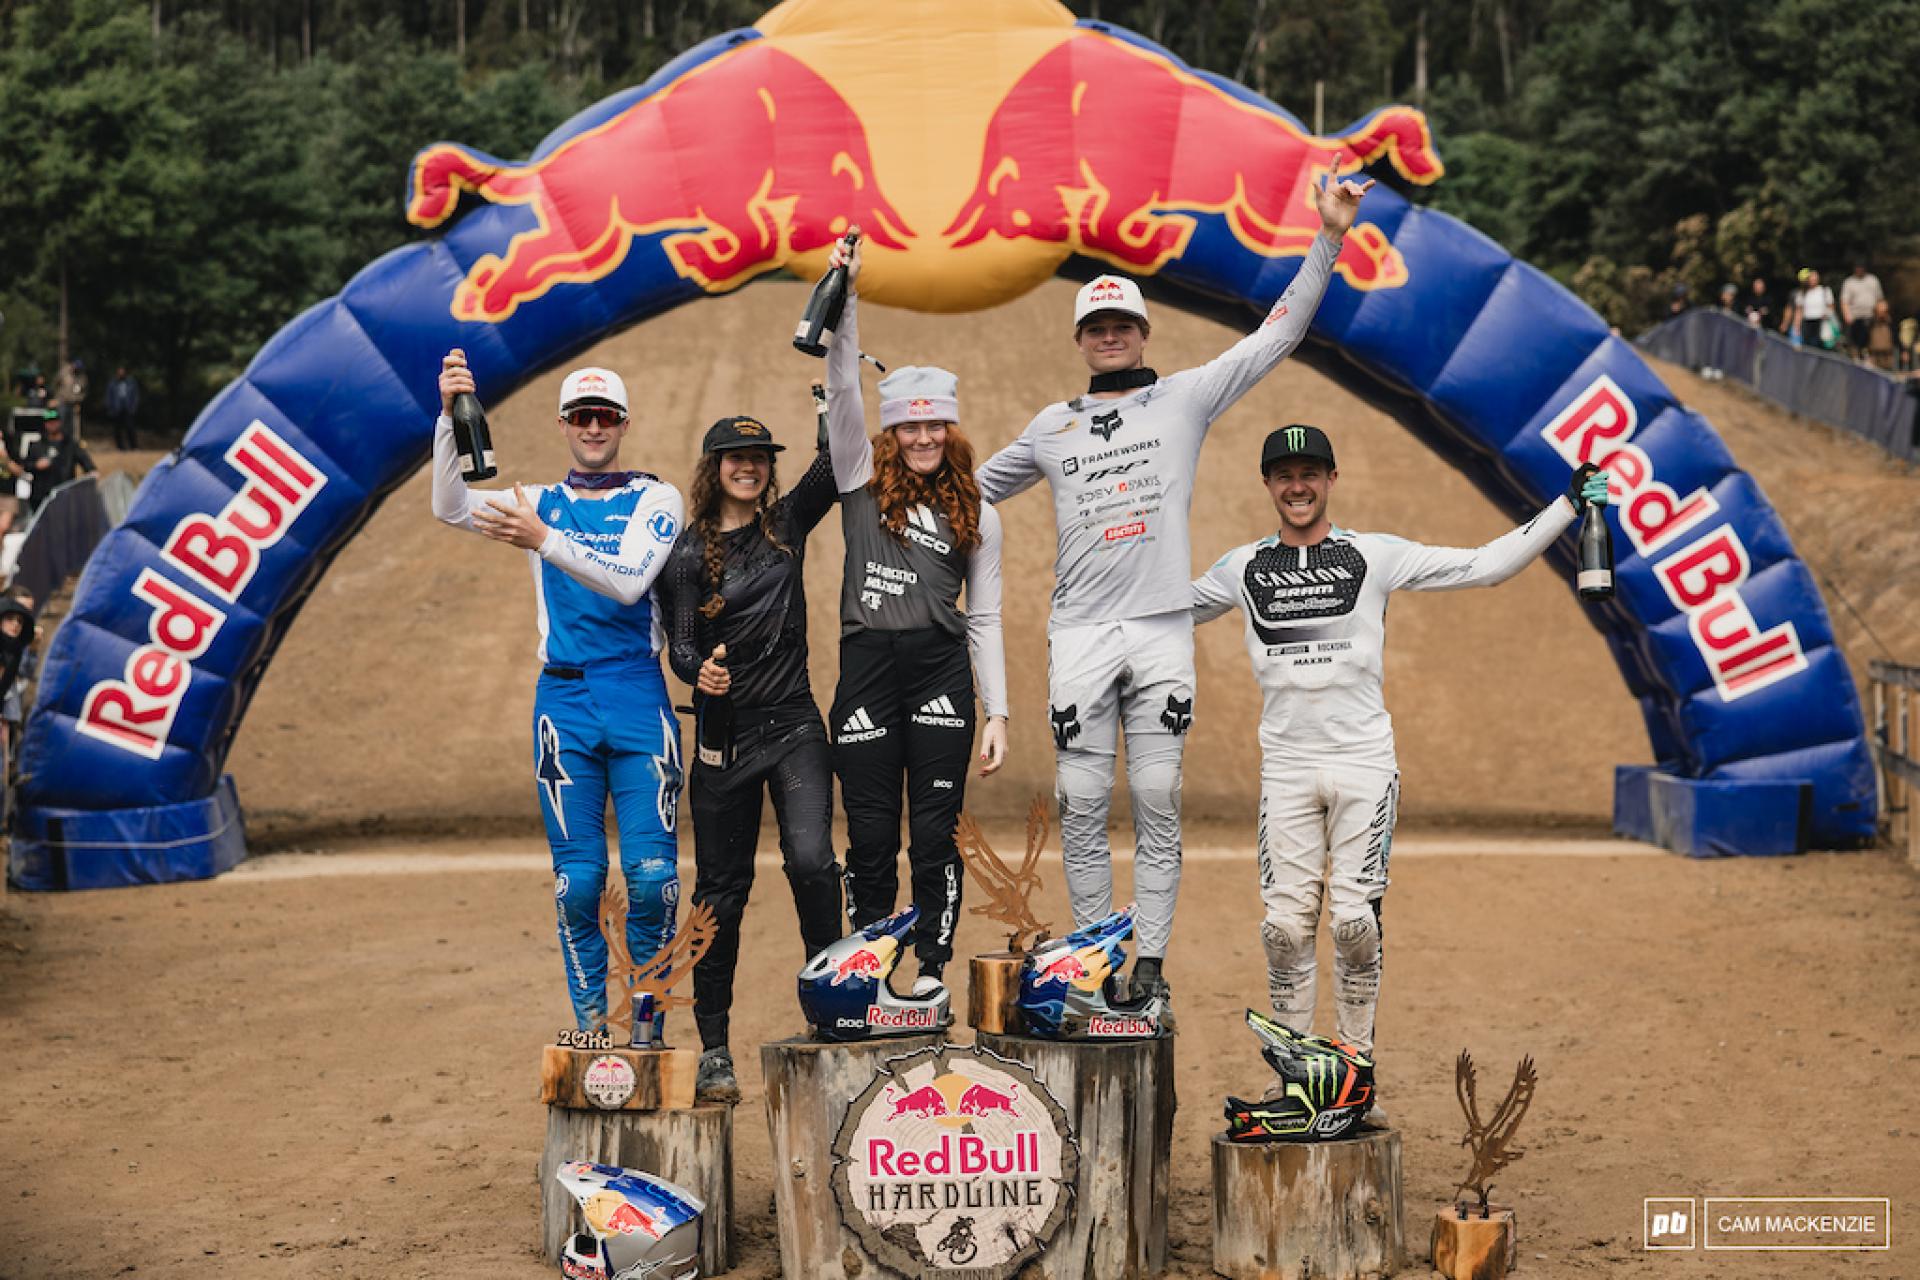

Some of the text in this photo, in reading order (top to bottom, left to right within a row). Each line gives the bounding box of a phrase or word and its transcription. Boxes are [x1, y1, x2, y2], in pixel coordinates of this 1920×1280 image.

[1081, 439, 1161, 465] FRAMEWORKS
[1552, 385, 1798, 692] Red Bull
[1253, 565, 1353, 588] CANYON
[84, 428, 315, 750] Red Bull
[1274, 584, 1334, 599] SRAM
[1293, 656, 1332, 667] MAXXIS
[911, 713, 966, 728] NORCO
[837, 727, 888, 745] NORCO
[937, 863, 958, 946] NORCO
[867, 1006, 938, 1027] Red Bull
[1089, 1016, 1126, 1034] Red
[867, 1131, 1040, 1177] Red Bull
[867, 1179, 1043, 1210] HARDLINE
